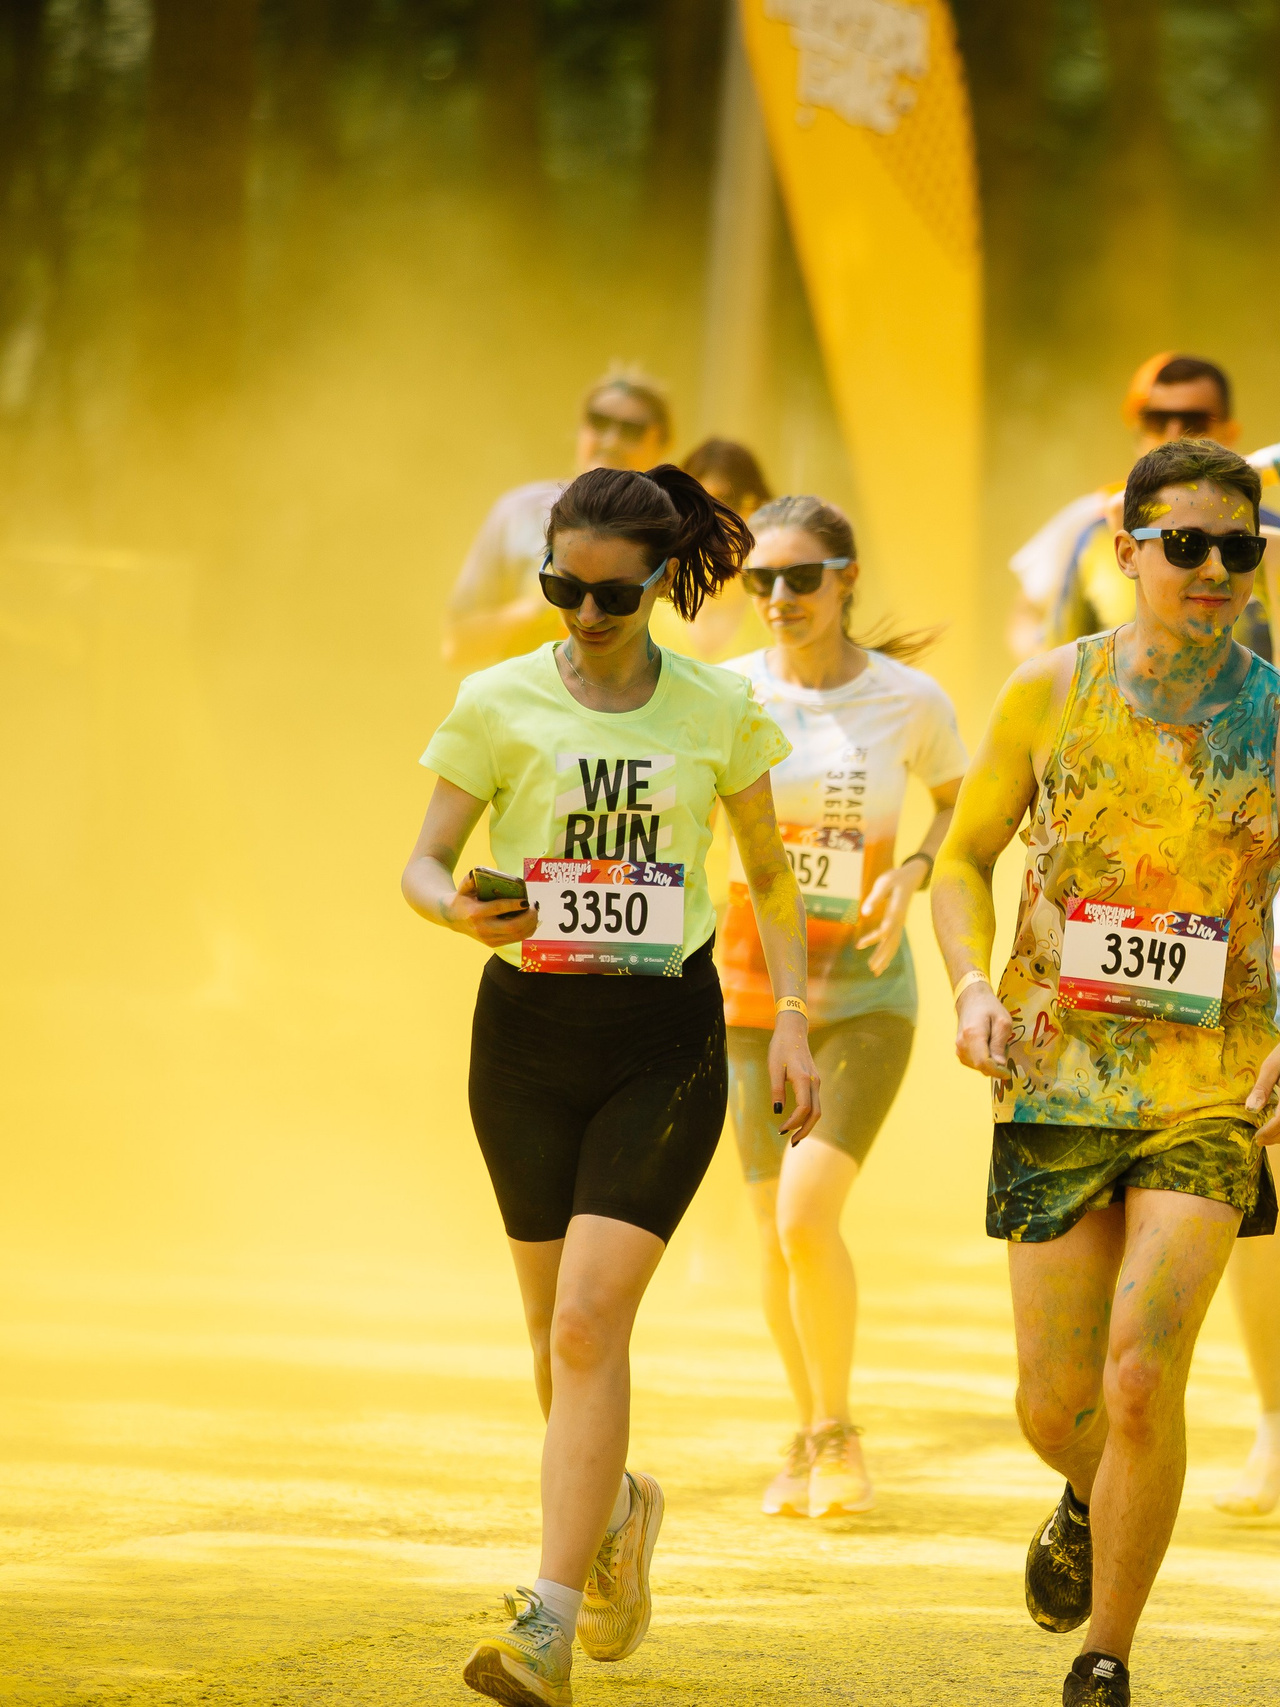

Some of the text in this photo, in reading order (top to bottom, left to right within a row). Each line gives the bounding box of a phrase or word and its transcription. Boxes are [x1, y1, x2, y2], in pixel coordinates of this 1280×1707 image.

[578, 758, 653, 812] WE
[564, 813, 660, 863] RUN
[540, 860, 592, 874] КРАСОЧНЫЙ
[549, 872, 582, 884] ЗАБЕГ
[558, 889, 648, 936] 3350
[1084, 902, 1136, 920] КРАСОЧНЫЙ
[1093, 914, 1127, 928] ЗАБЕГ
[1100, 933, 1186, 985] 3349
[1096, 1658, 1117, 1672] NIKE
